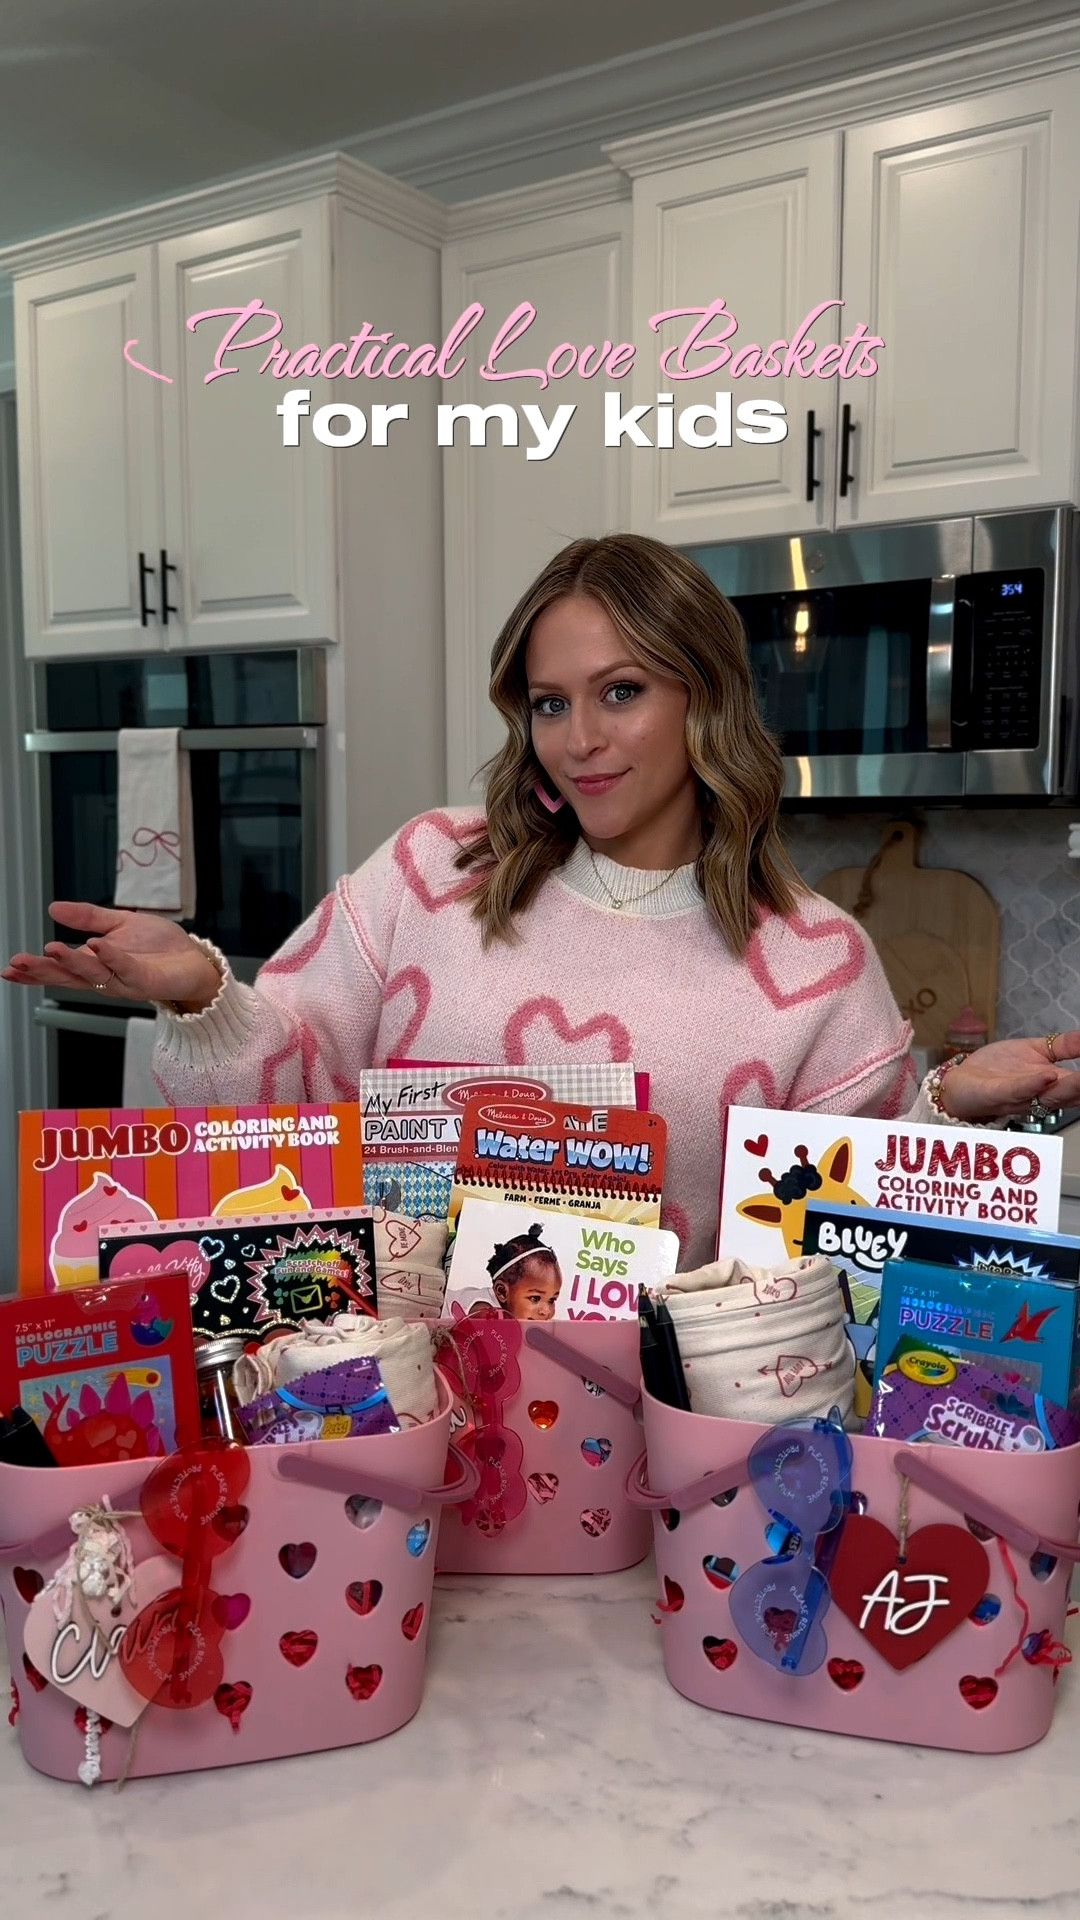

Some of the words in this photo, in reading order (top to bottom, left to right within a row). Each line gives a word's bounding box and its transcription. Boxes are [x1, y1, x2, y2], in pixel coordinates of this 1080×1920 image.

[364, 1094, 392, 1118] My
[398, 1081, 446, 1108] First
[486, 1108, 519, 1120] Melissa
[33, 1122, 191, 1171] JUMBO
[194, 1118, 296, 1137] COLORING
[297, 1115, 339, 1131] AND
[193, 1134, 286, 1153] ACTIVITY
[289, 1131, 340, 1147] BOOK
[364, 1119, 447, 1141] PAINT
[364, 1146, 377, 1154] 24
[380, 1144, 458, 1154] Brush-and-Blen
[476, 1128, 560, 1164] Water
[565, 1137, 651, 1176] WOW!
[874, 1134, 1041, 1185] JUMBO
[488, 1162, 507, 1170] Color
[509, 1163, 525, 1172] with
[582, 1172, 601, 1180] Color
[504, 1193, 526, 1202] FARM
[534, 1196, 561, 1205] FERME
[568, 1199, 601, 1210] GRANJA
[877, 1175, 981, 1201] COLORING
[991, 1186, 1038, 1206] AND
[875, 1193, 966, 1217] ACTIVITY
[978, 1203, 1038, 1225] BOOK
[581, 1227, 636, 1255] Who
[575, 1249, 628, 1278] Says
[570, 1274, 580, 1301] I
[587, 1276, 641, 1312] LOV
[15, 1323, 33, 1333] 7.5"
[15, 1319, 116, 1345] HOLOGRAPHIC
[899, 1306, 995, 1341] PUZZLE
[17, 1331, 118, 1368] PUZZLE
[908, 1355, 946, 1371] Crayola
[946, 1397, 1010, 1436] SCRIBBLE
[808, 1445, 829, 1473] PLEASE
[210, 1464, 228, 1494] PLEASE
[806, 1475, 829, 1504] REMOVE
[200, 1495, 226, 1526] REMOVE
[861, 1570, 950, 1635] AJ
